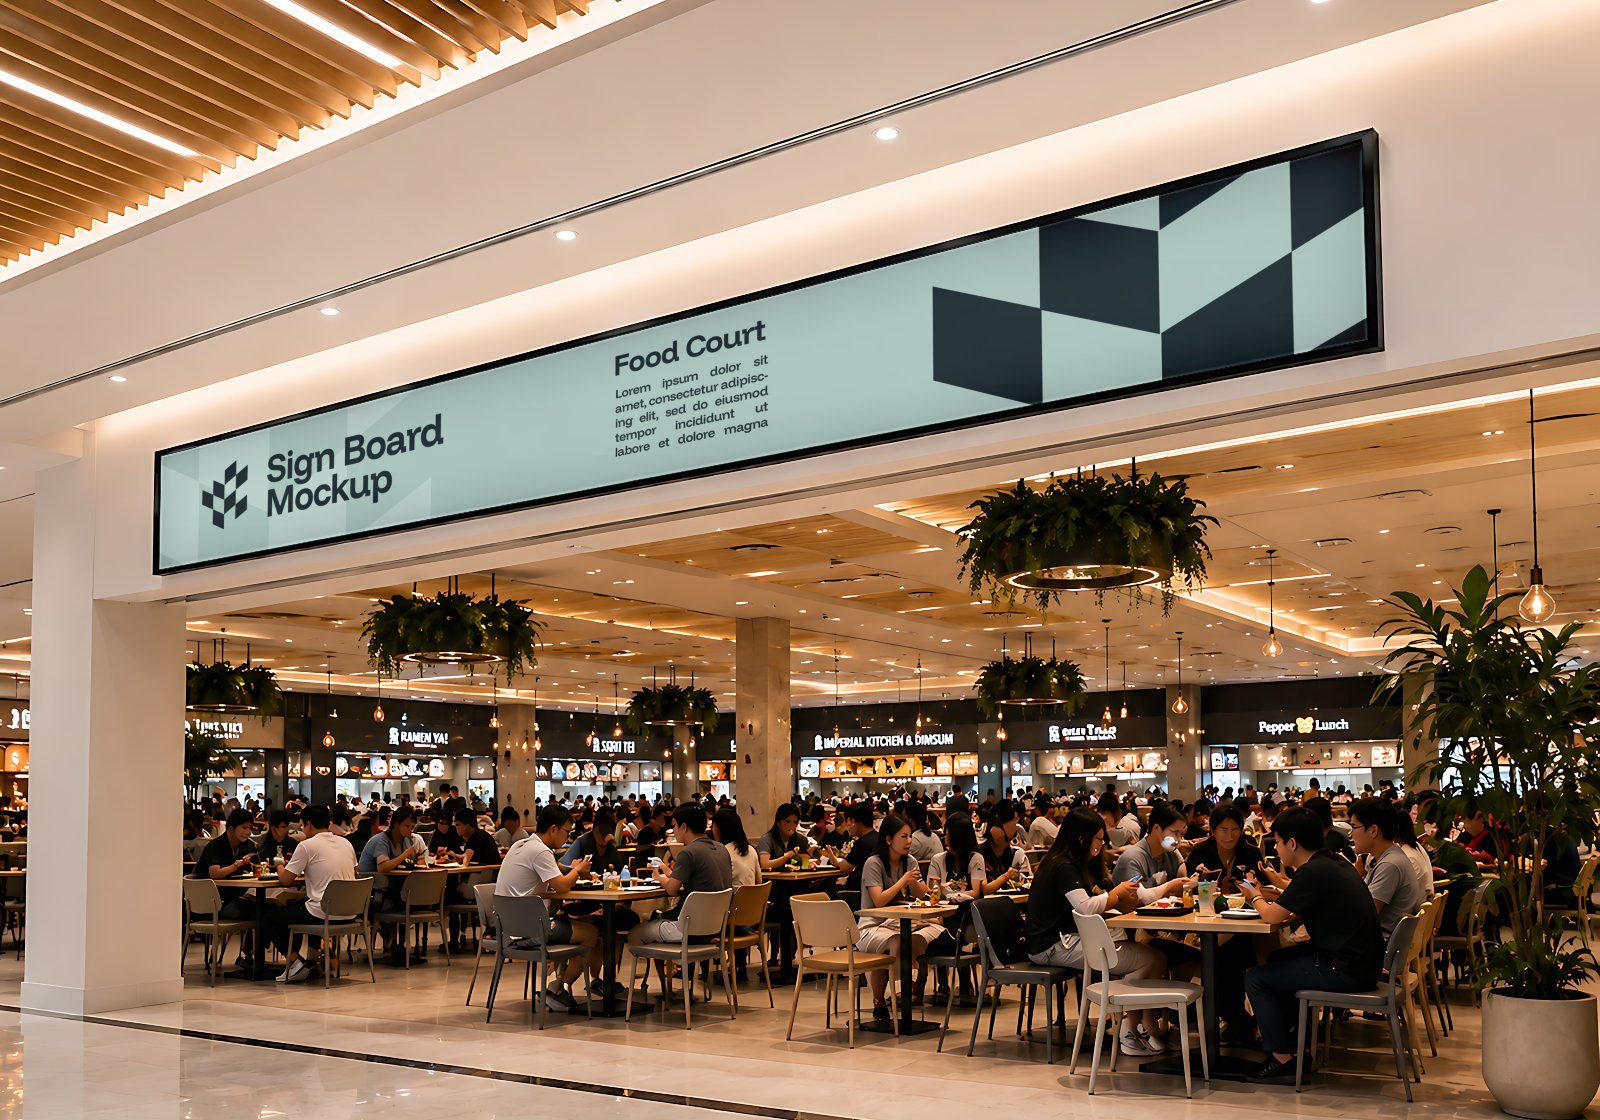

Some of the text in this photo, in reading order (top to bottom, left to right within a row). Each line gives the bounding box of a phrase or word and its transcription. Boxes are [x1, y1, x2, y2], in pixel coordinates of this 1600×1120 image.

[615, 320, 766, 376] Food Court
[615, 355, 769, 399] Lorem ipsum dolor sit
[615, 373, 769, 413] amet, consectetur adipisc-
[615, 385, 769, 428] ing elit, sed do eiusmod
[615, 402, 769, 442] tempor incididunt ut
[266, 413, 444, 485] Sign Board
[615, 419, 769, 457] labore et dolore magna
[267, 469, 393, 518] Mockup
[400, 731, 449, 745] RAMEN YA!
[905, 735, 914, 746] &
[1258, 718, 1349, 735] Pepper Lunch
